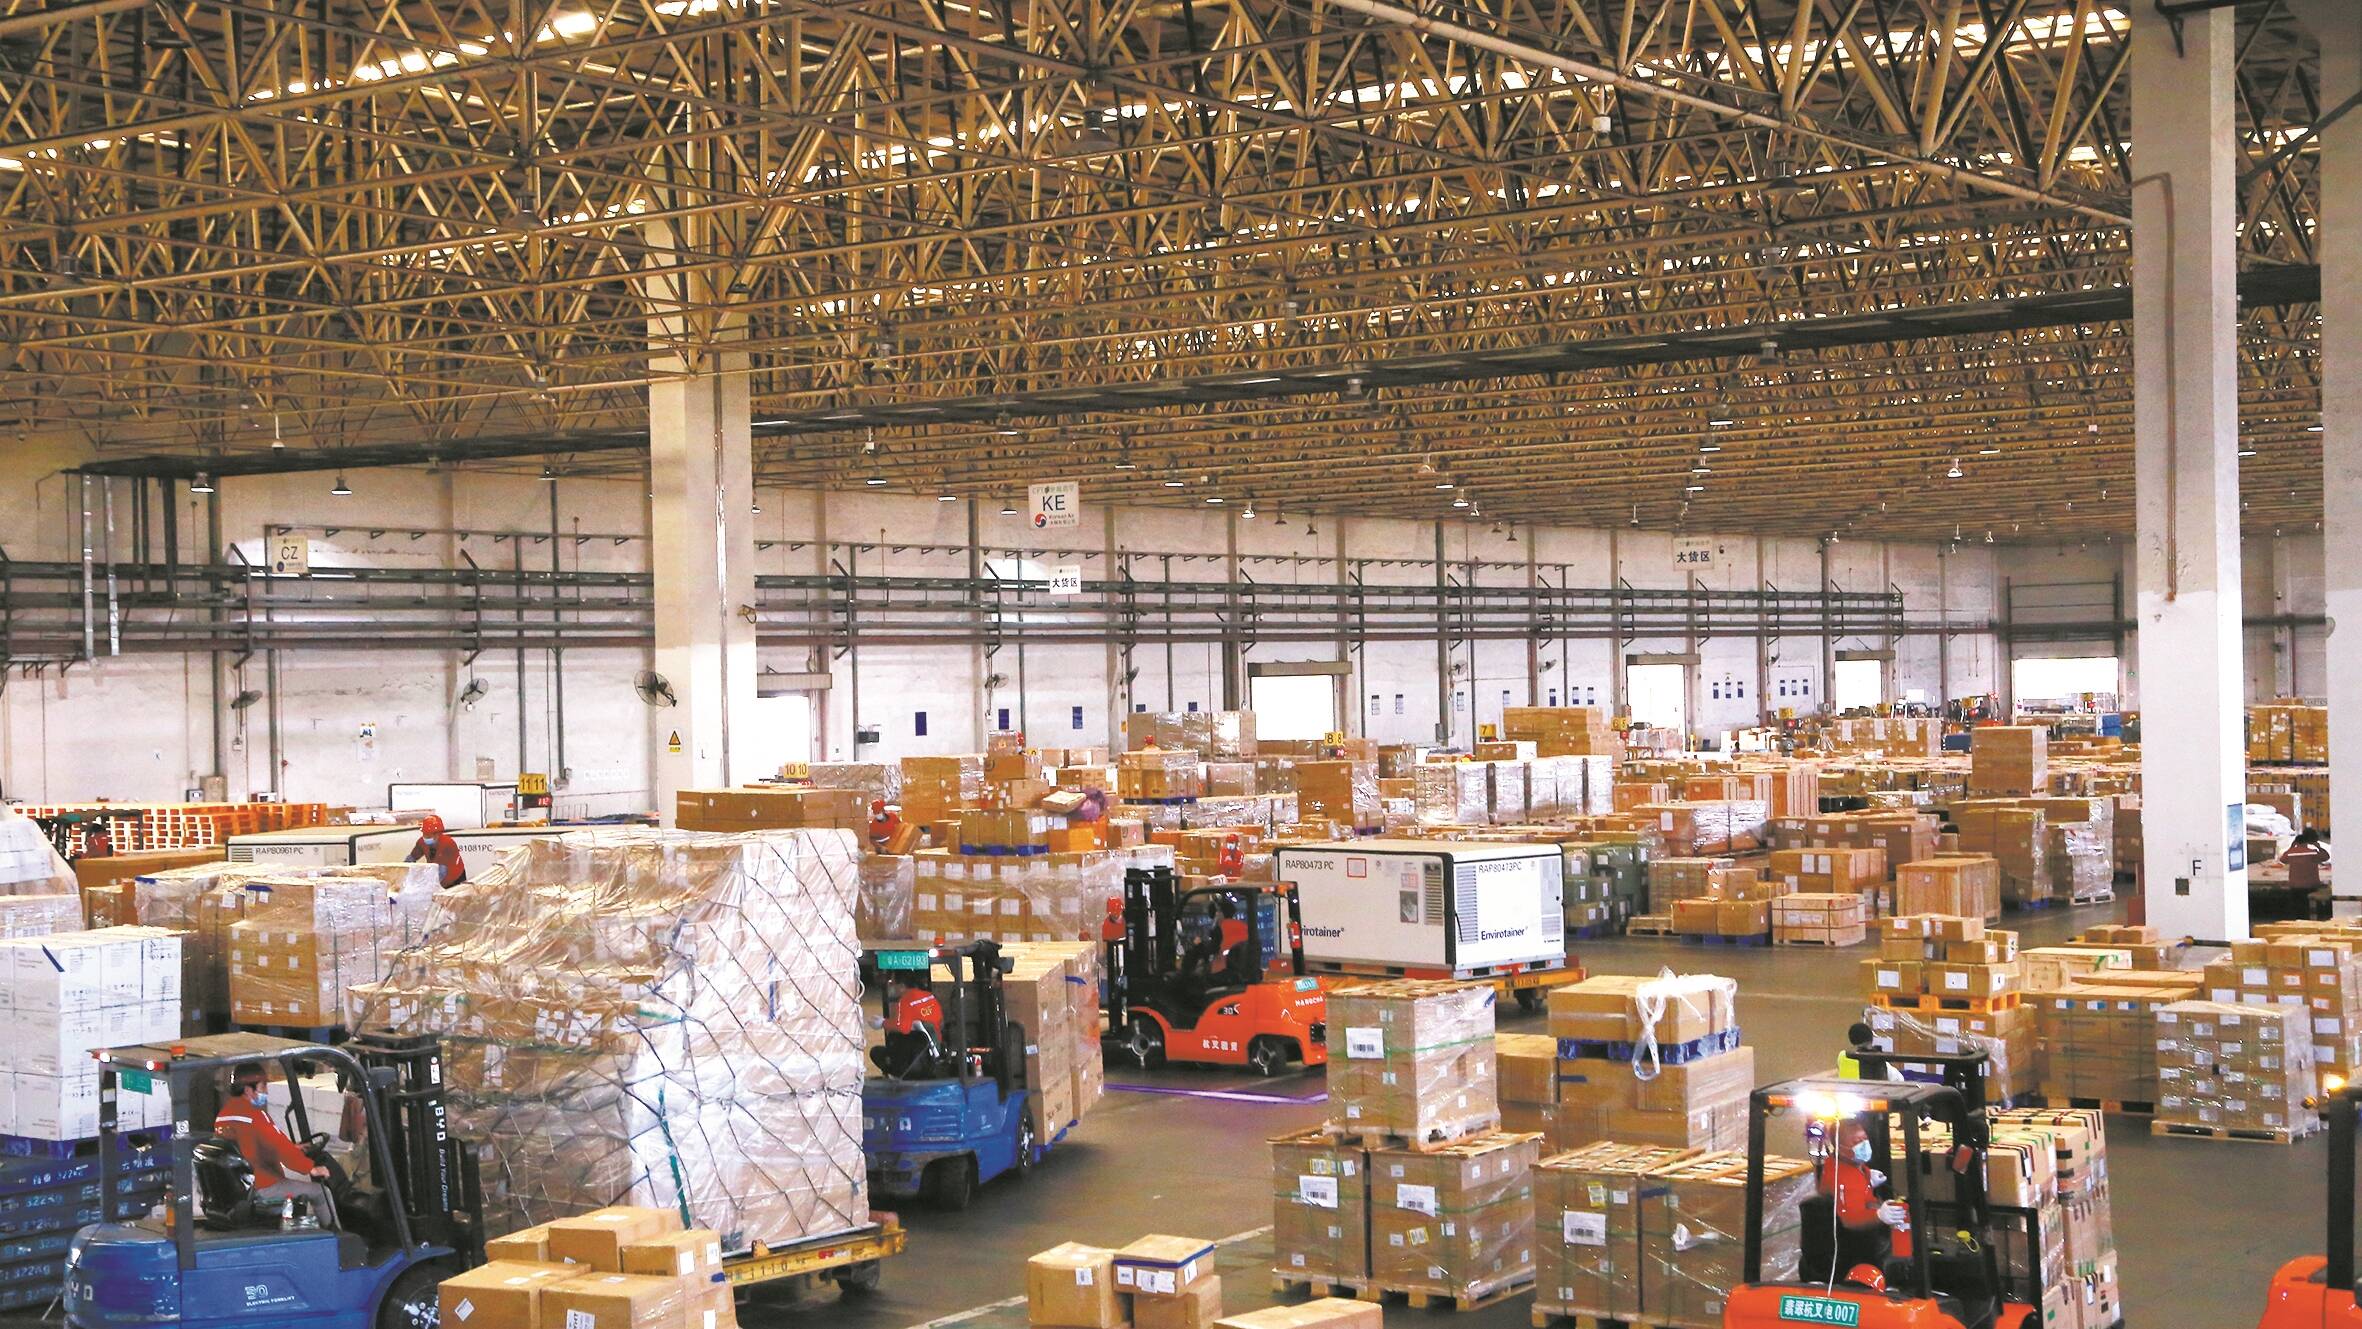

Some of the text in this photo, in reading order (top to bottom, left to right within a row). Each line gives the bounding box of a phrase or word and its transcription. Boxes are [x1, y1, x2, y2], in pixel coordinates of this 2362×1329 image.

[1042, 494, 1065, 511] KE
[281, 546, 298, 560] CZ
[1677, 551, 1709, 563] 大货区
[1052, 578, 1077, 588] 大货区
[1481, 725, 1488, 735] 7
[1327, 733, 1334, 743] 8
[785, 763, 807, 775] 10 10
[521, 778, 545, 790] 11 11
[2192, 860, 2202, 876] F
[1481, 927, 1525, 940] Envirotainer
[1223, 1006, 1233, 1015] 30
[435, 1106, 446, 1141] BYD
[246, 1299, 270, 1307] ELECTRIC
